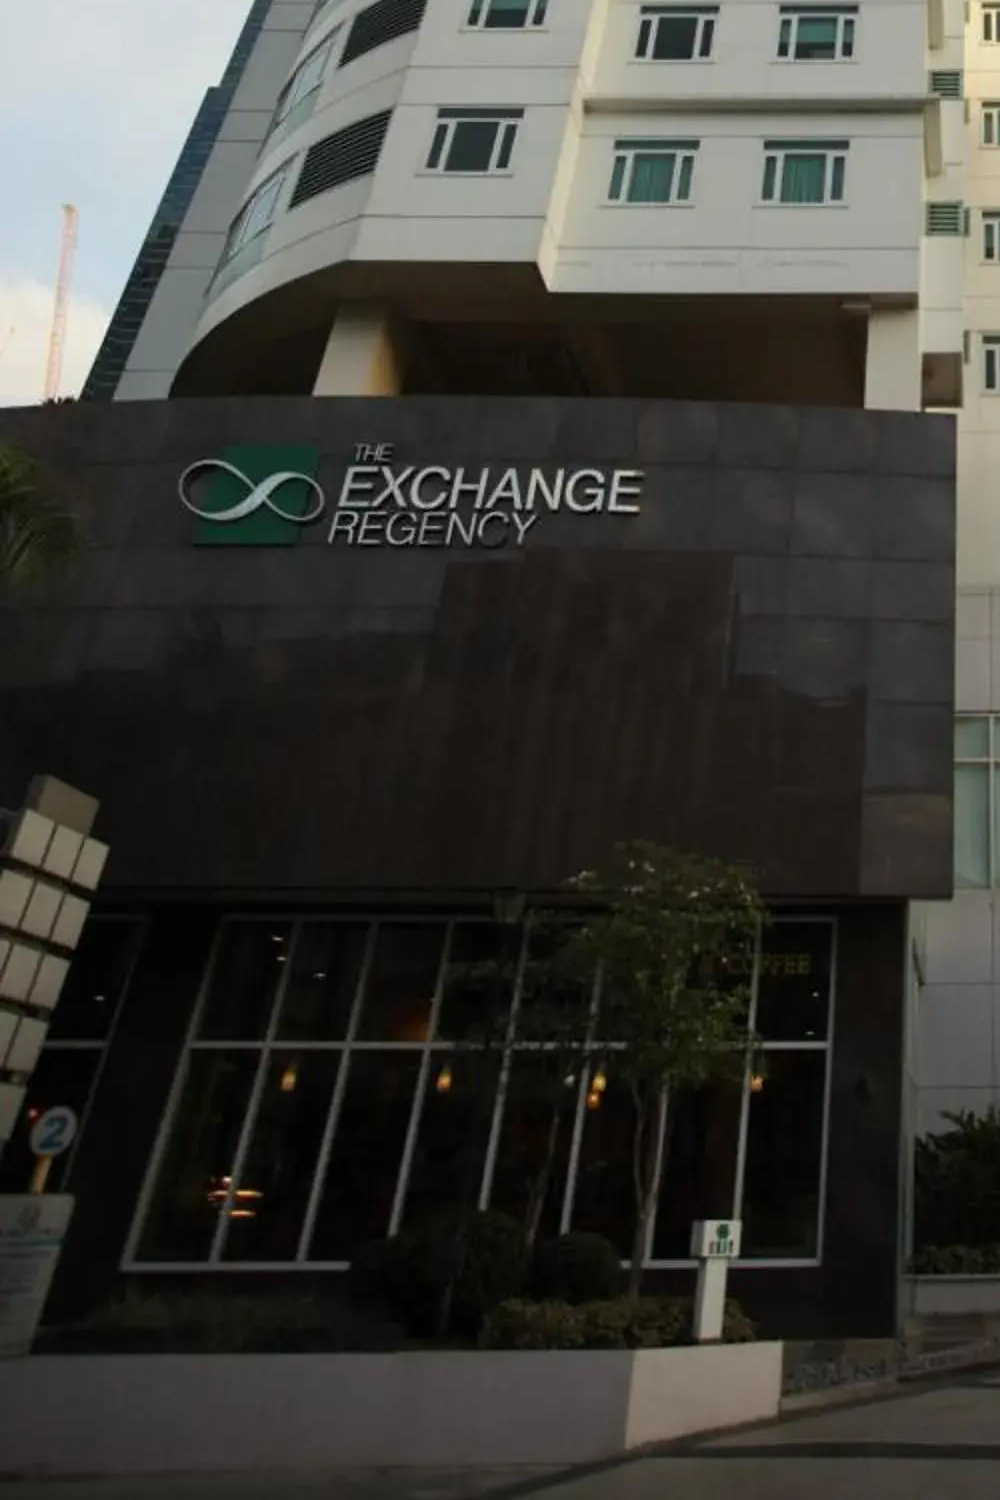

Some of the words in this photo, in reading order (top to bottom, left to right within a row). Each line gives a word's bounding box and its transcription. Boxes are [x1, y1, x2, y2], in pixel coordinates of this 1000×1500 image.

[352, 442, 395, 462] THE
[338, 465, 645, 513] EXCHANGE
[327, 510, 539, 546] REGENCY
[40, 1116, 68, 1150] 2
